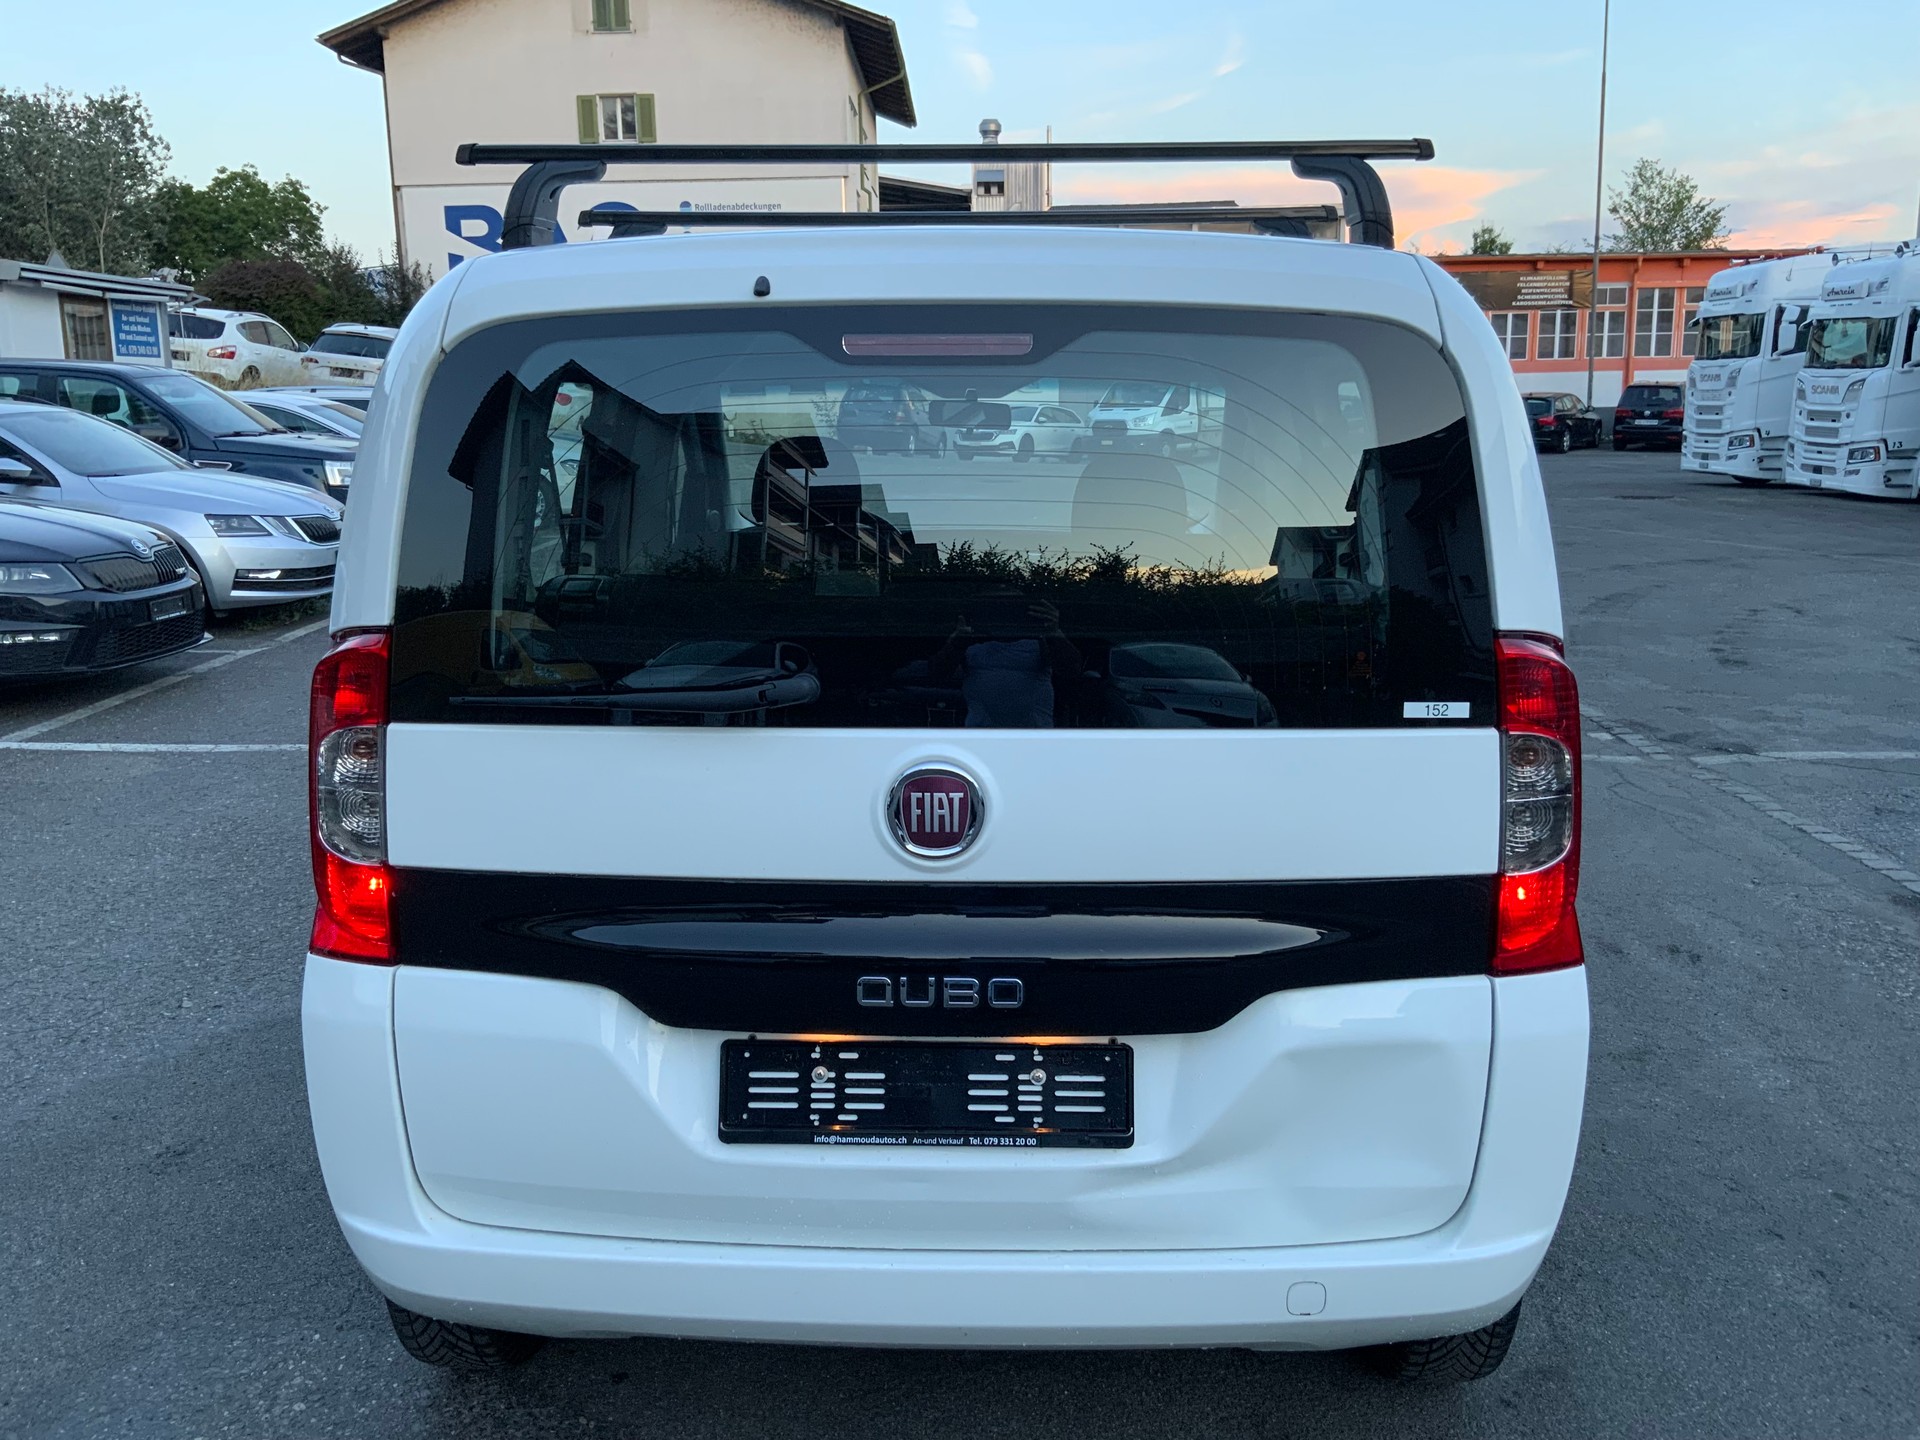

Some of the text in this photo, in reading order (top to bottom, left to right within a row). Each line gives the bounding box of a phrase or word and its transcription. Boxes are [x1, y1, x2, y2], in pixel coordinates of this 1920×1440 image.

[694, 203, 782, 212] Rollladenabdeckungen
[1811, 384, 1840, 395] SCANIA
[1425, 704, 1449, 716] 152
[910, 792, 964, 833] FIAT
[856, 976, 1024, 1008] QUBO
[813, 1135, 907, 1145] info@hammoudautos.ch
[938, 1137, 964, 1145] Verkauf
[968, 1137, 983, 1145] Tel.
[983, 1137, 998, 1146] 079
[999, 1137, 1014, 1146] 331
[1015, 1137, 1026, 1146] 20
[1026, 1138, 1037, 1146] 00
